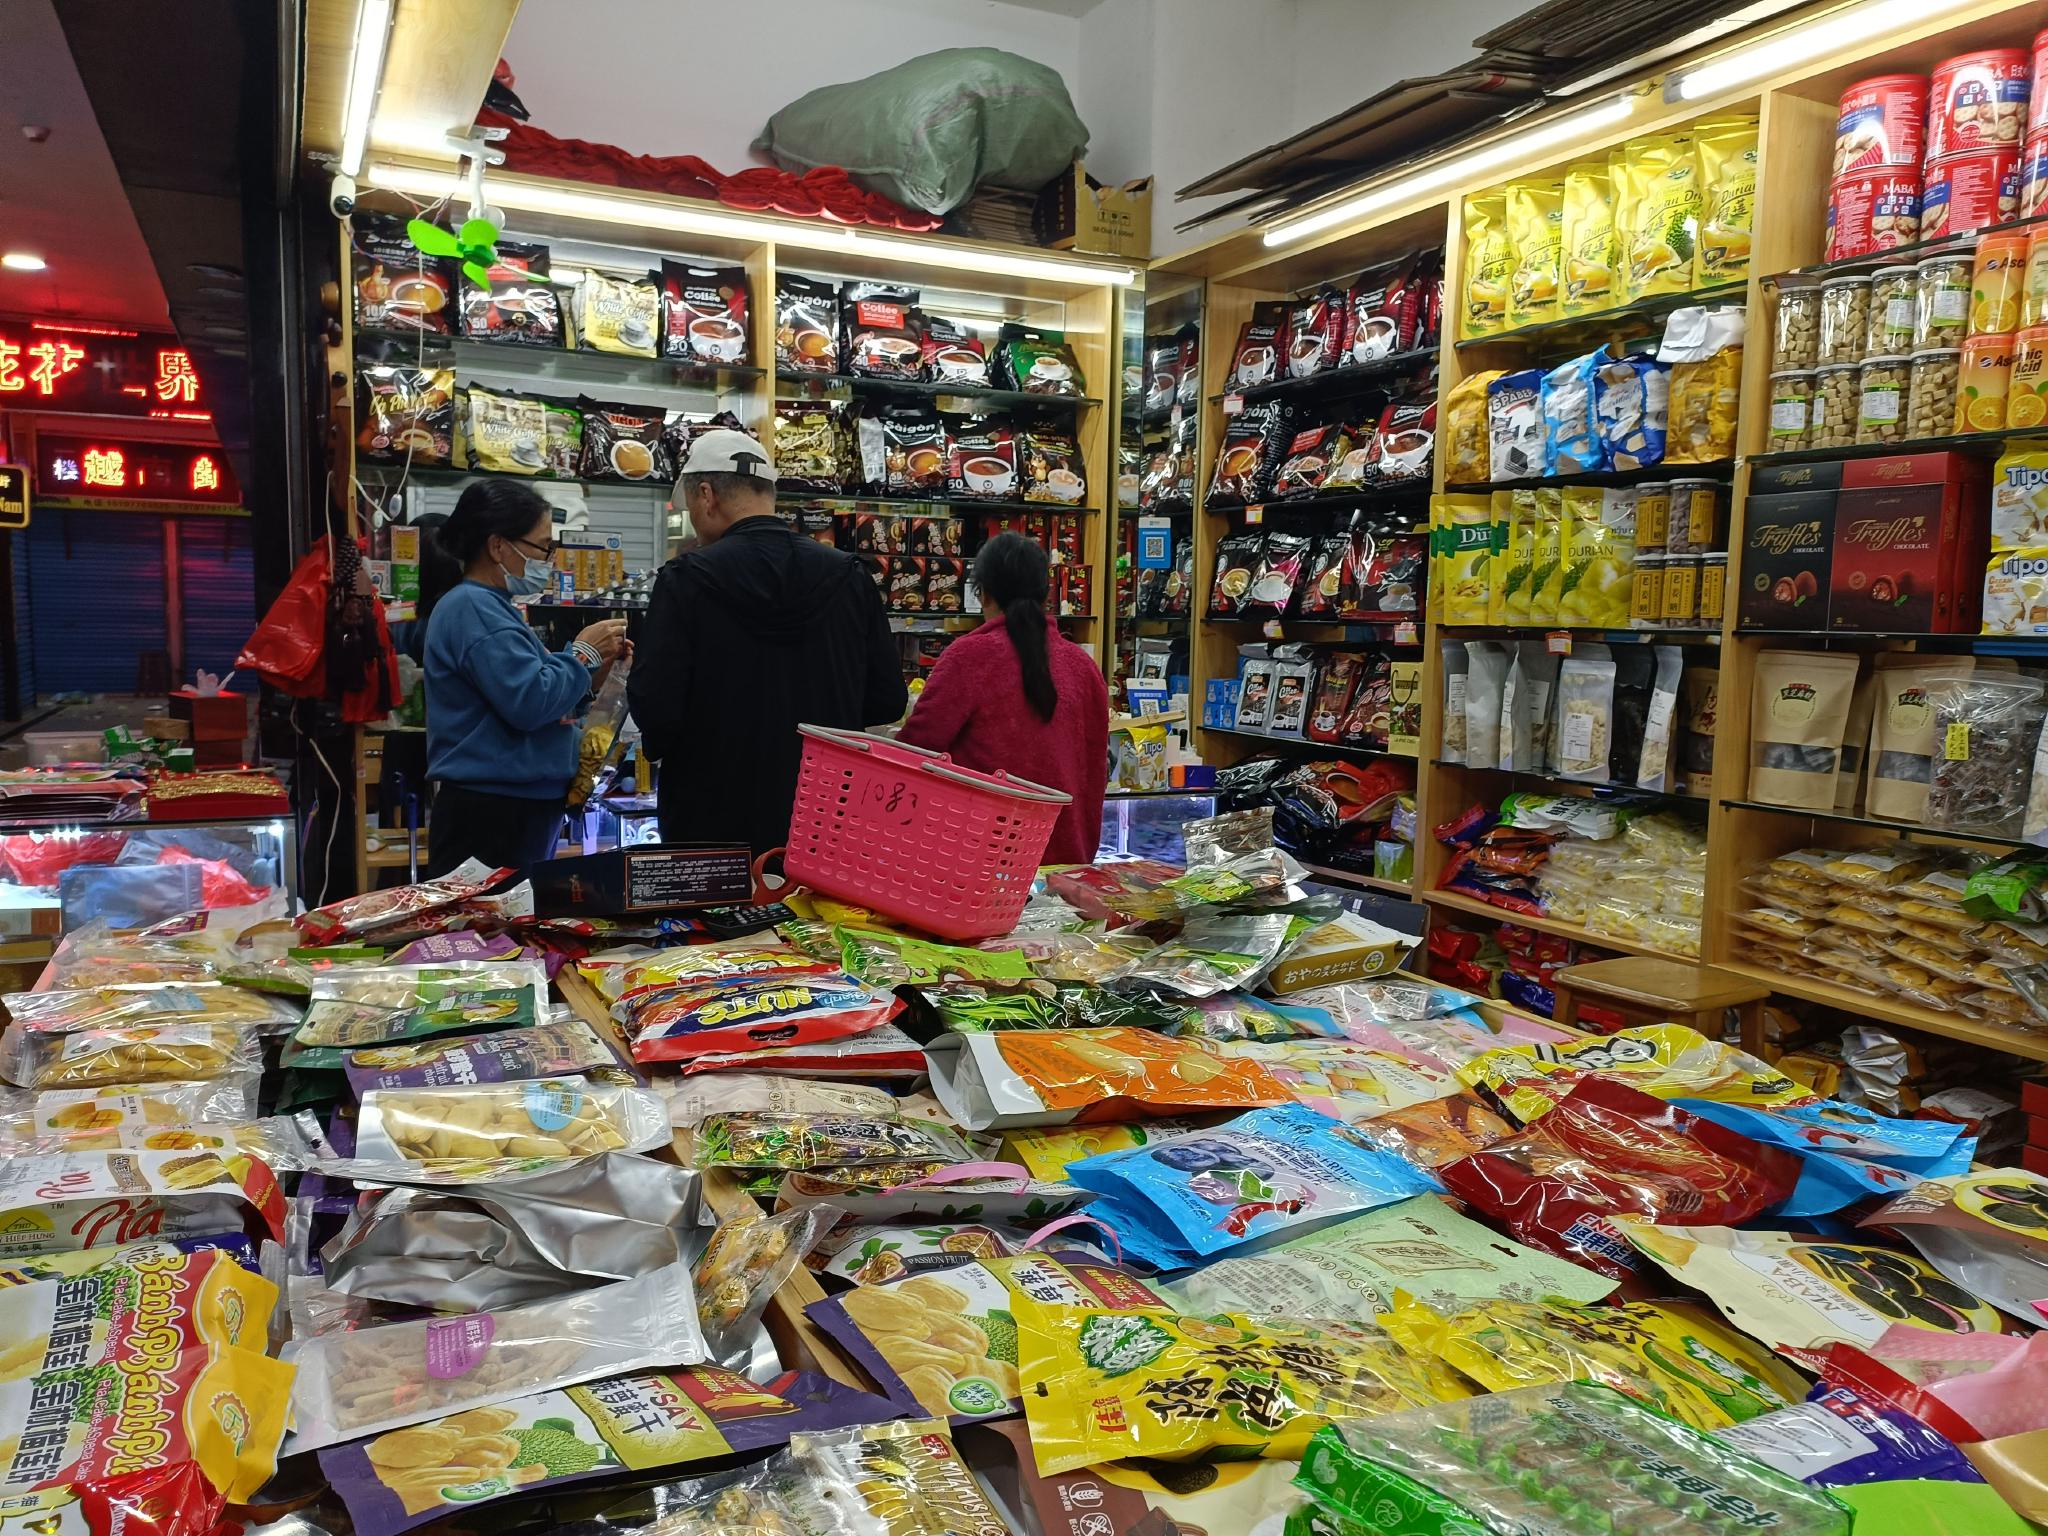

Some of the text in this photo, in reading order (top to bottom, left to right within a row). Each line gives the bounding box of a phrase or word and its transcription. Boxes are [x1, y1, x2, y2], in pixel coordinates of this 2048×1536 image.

[860, 302, 899, 316] Coffee
[2015, 358, 2043, 374] Acid
[1567, 545, 1615, 558] DURIAN
[697, 984, 812, 1026] NUTS
[51, 1202, 65, 1210] TM
[71, 1198, 165, 1250] Pía
